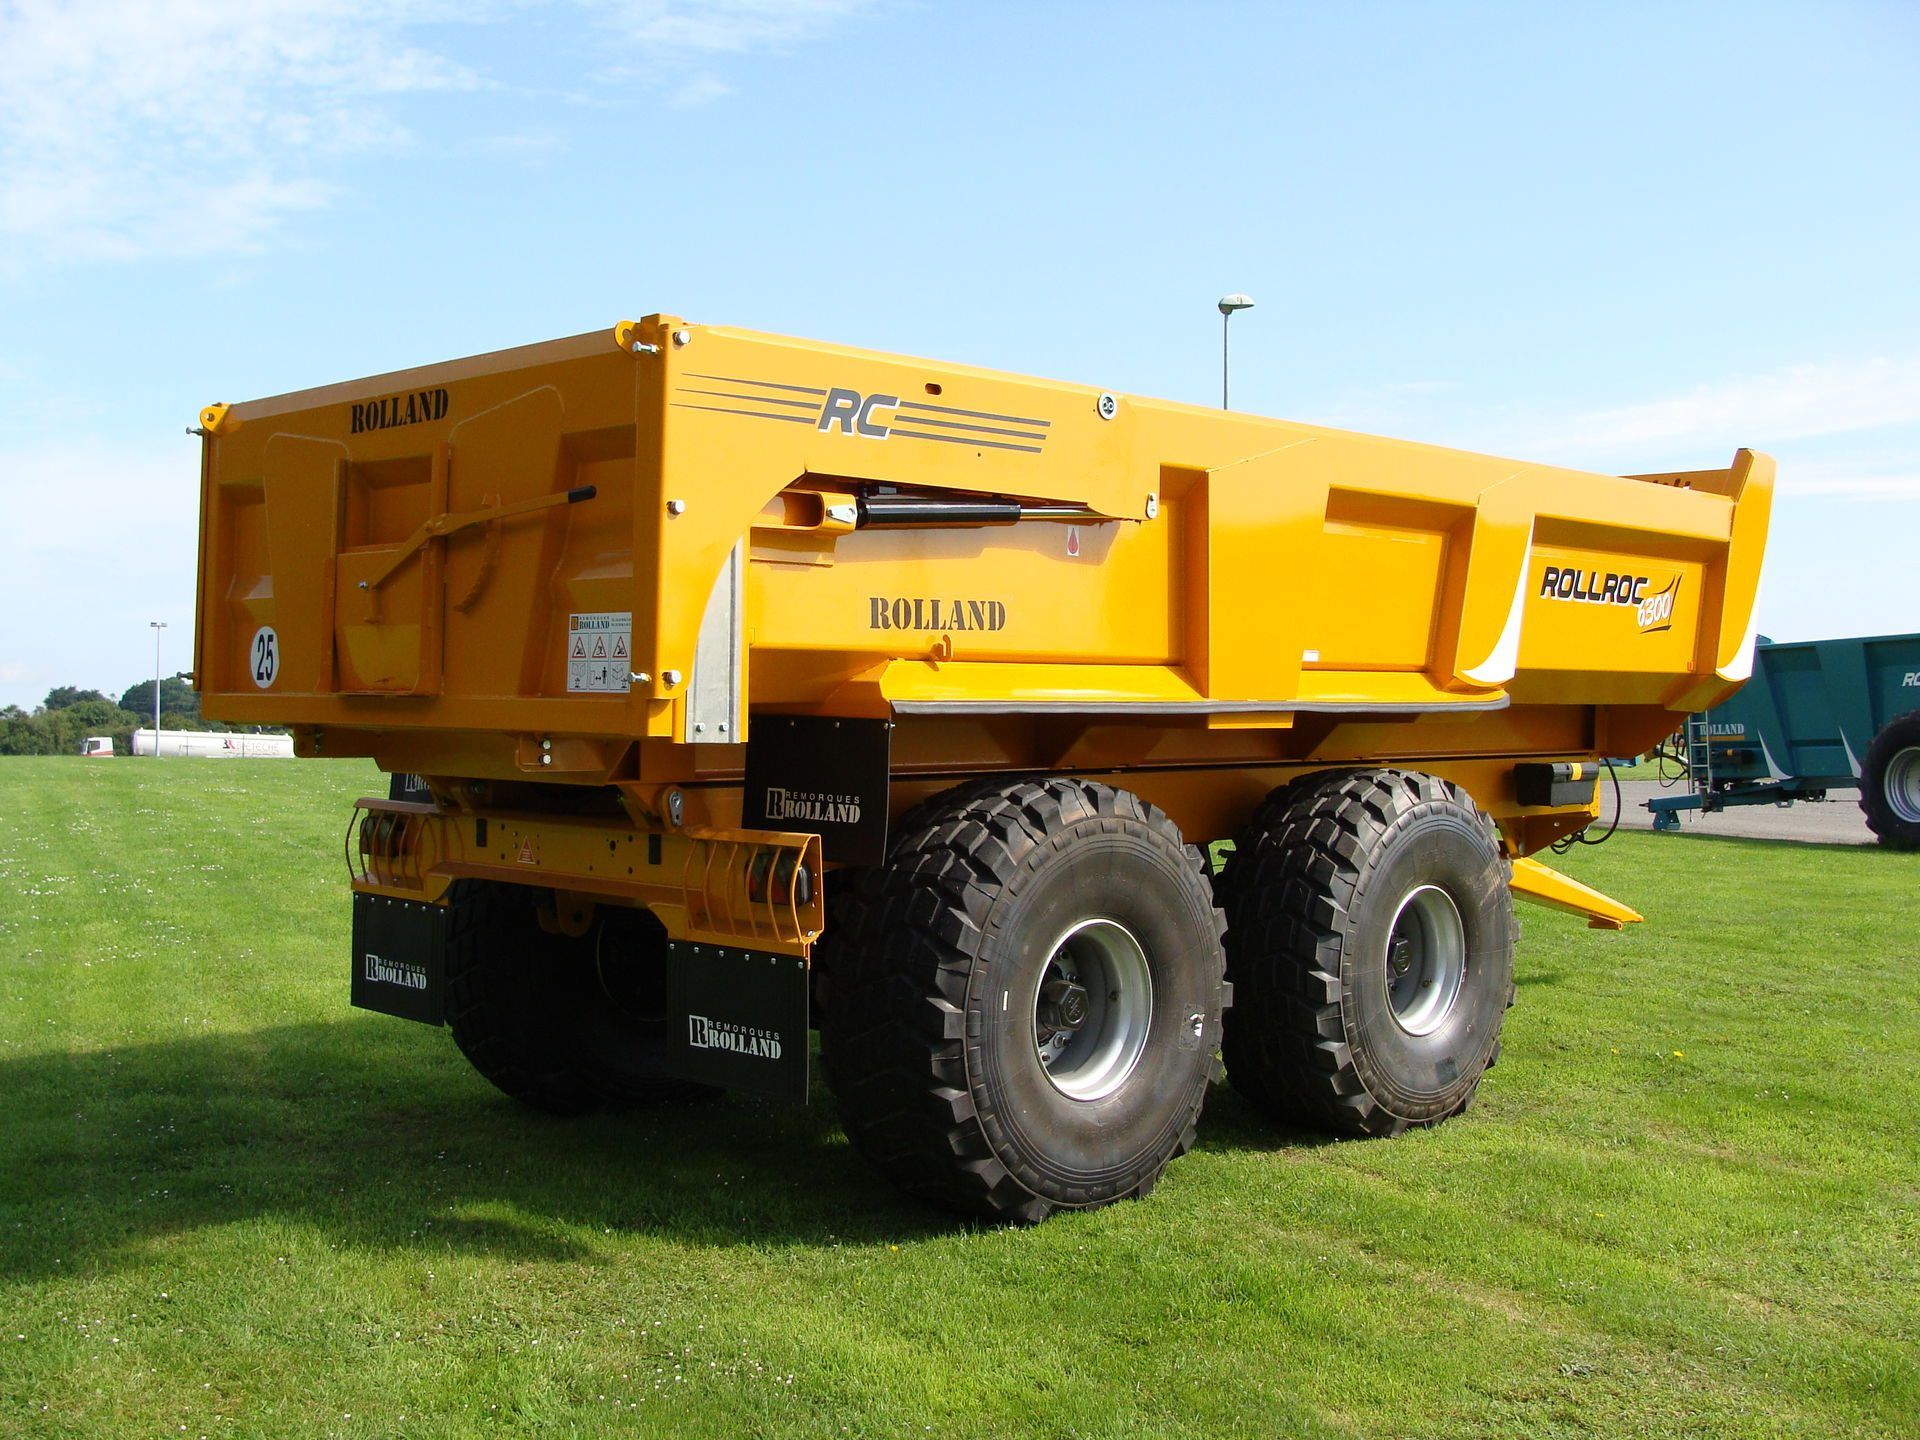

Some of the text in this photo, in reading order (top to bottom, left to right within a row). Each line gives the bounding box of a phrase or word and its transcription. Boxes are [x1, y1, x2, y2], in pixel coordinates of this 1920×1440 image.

[351, 388, 448, 434] ROLLAND
[818, 387, 900, 440] RC
[1540, 566, 1650, 607] ROLLROC
[579, 620, 610, 630] ROLLAND
[869, 597, 1006, 631] ROLLAND
[1637, 592, 1671, 628] 6300
[256, 634, 274, 681] 25
[1699, 723, 1745, 736] ROLLAND
[784, 799, 861, 824] ROLLAND
[785, 791, 860, 804] REMORQUES
[378, 965, 427, 990] ROLLAND
[708, 1020, 780, 1040] REMORQUES
[708, 1029, 782, 1060] ROLLAND
